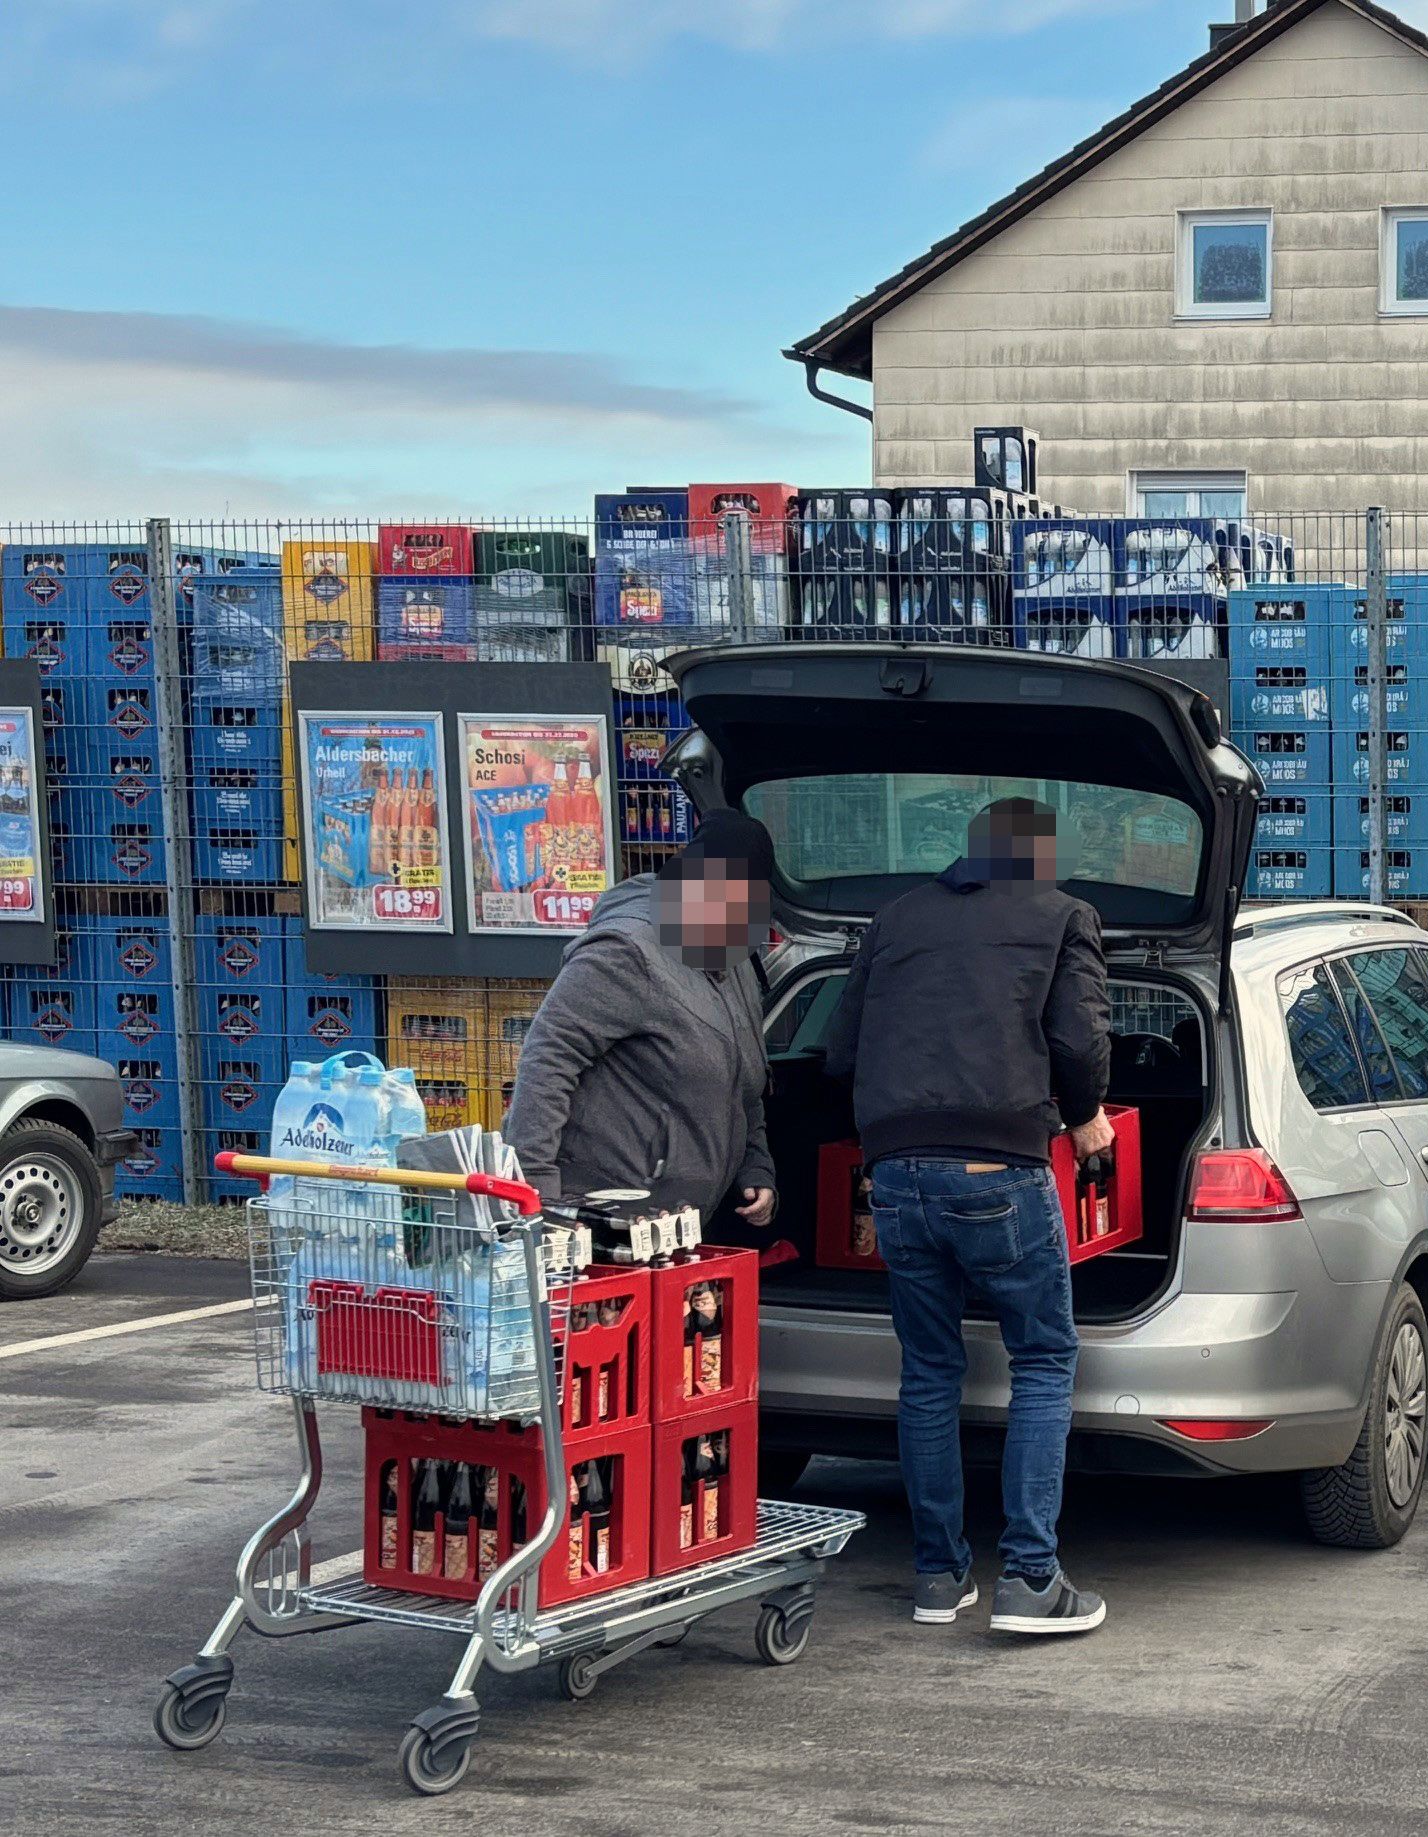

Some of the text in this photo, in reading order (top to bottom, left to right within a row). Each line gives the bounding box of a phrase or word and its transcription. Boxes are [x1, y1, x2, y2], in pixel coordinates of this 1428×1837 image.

[315, 745, 413, 762] Aldersbacher
[475, 748, 525, 765] Schosi
[630, 742, 659, 761] Spezi
[476, 770, 497, 781] ACE
[380, 889, 436, 914] 18.99
[543, 896, 593, 919] 11.99
